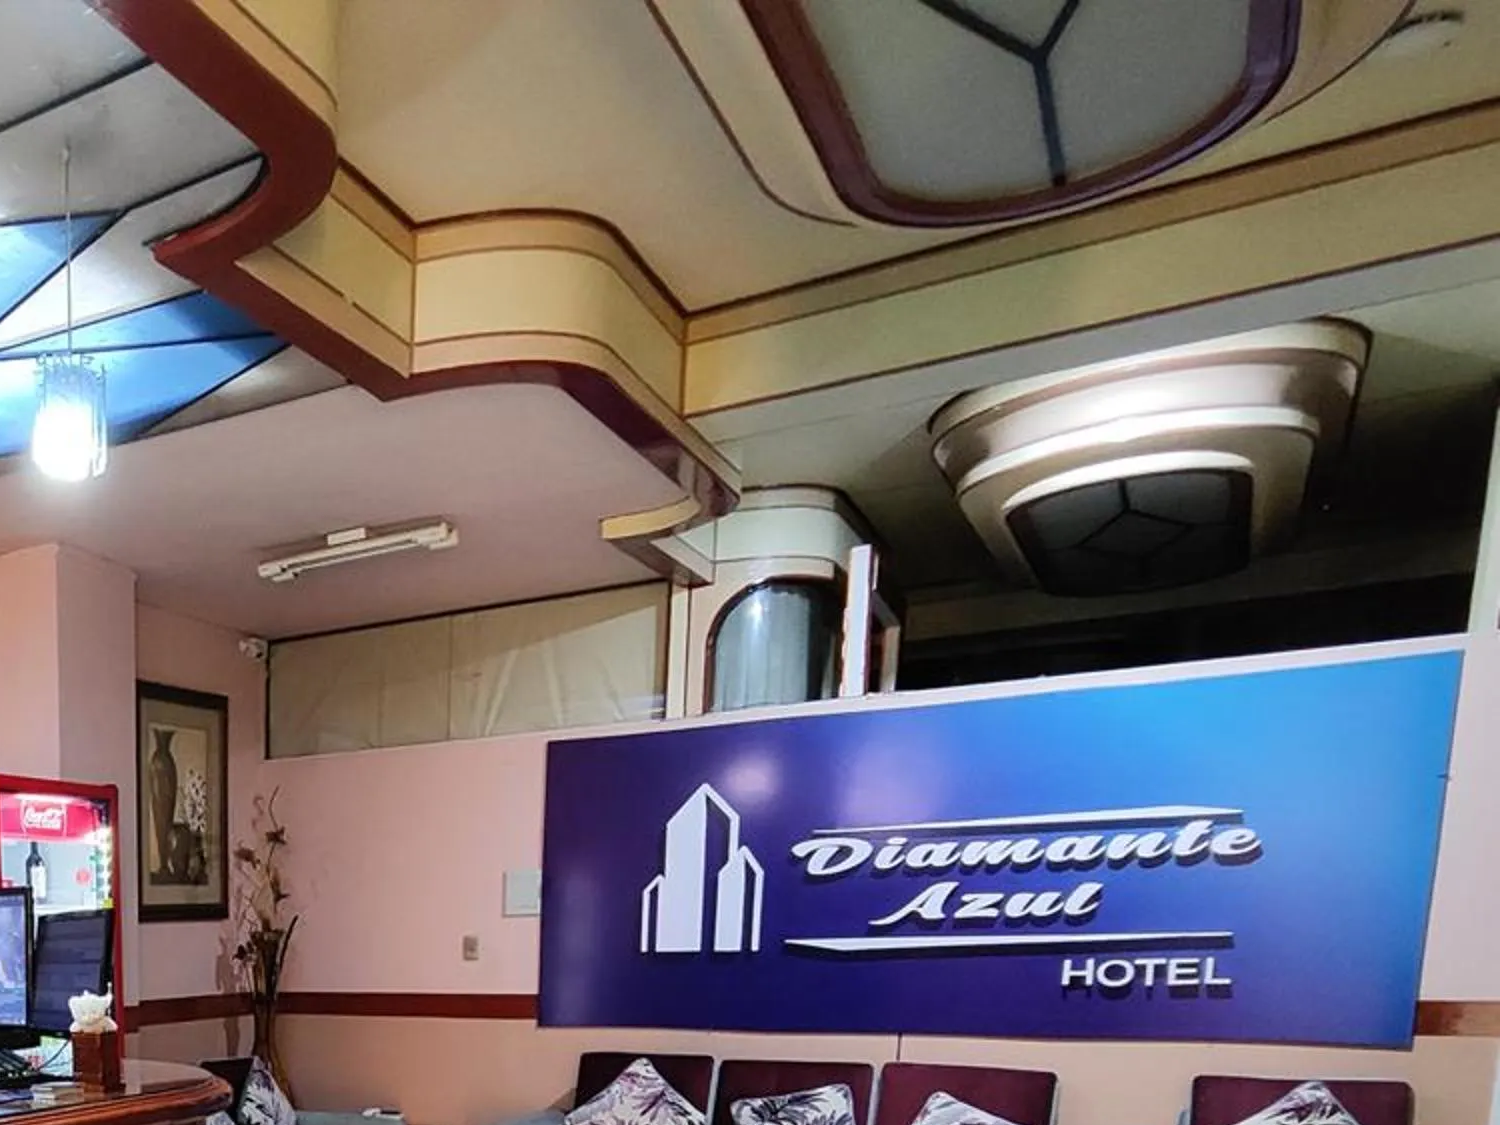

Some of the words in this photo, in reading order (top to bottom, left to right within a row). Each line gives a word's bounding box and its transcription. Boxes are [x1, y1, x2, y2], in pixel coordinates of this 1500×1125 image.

[791, 819, 1263, 876] Diamante
[868, 881, 1104, 926] Azul
[1060, 956, 1233, 988] HOTEL
